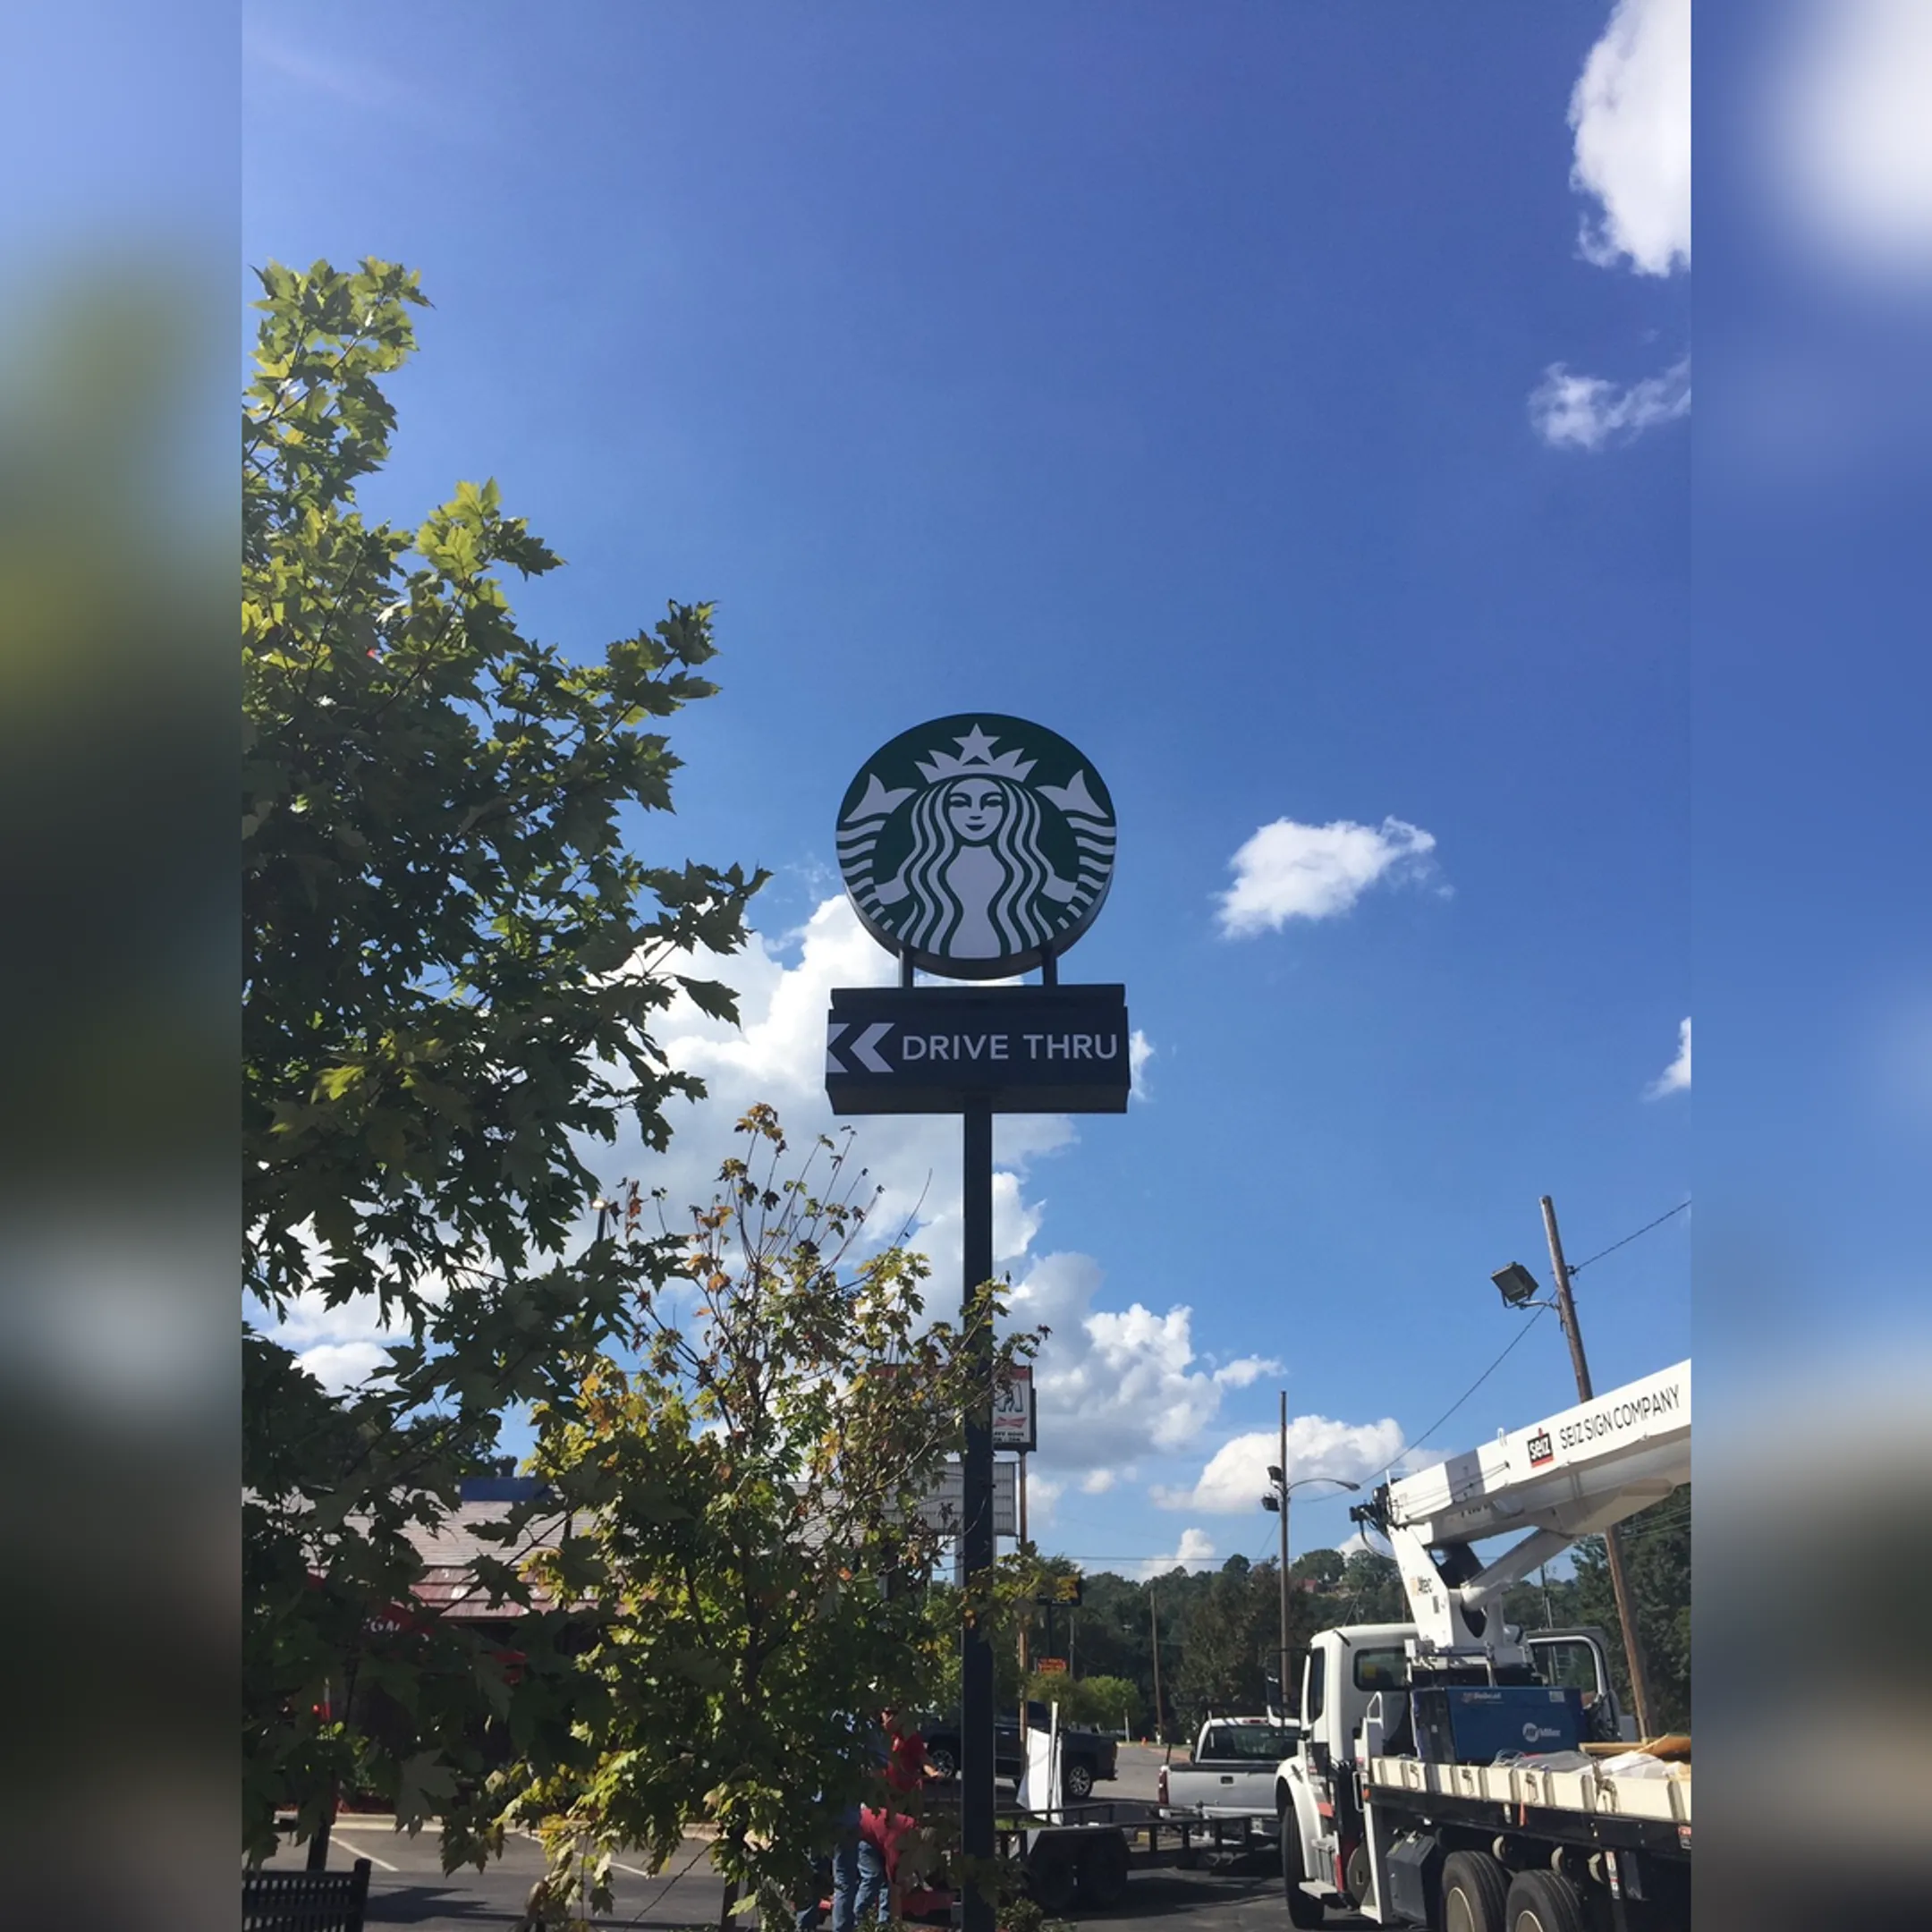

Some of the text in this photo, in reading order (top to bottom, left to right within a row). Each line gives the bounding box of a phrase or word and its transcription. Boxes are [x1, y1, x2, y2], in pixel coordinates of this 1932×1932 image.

[902, 1033, 1117, 1061] DRIVE THRU
[1559, 1384, 1680, 1450] SEIZ SIGN COMPANY
